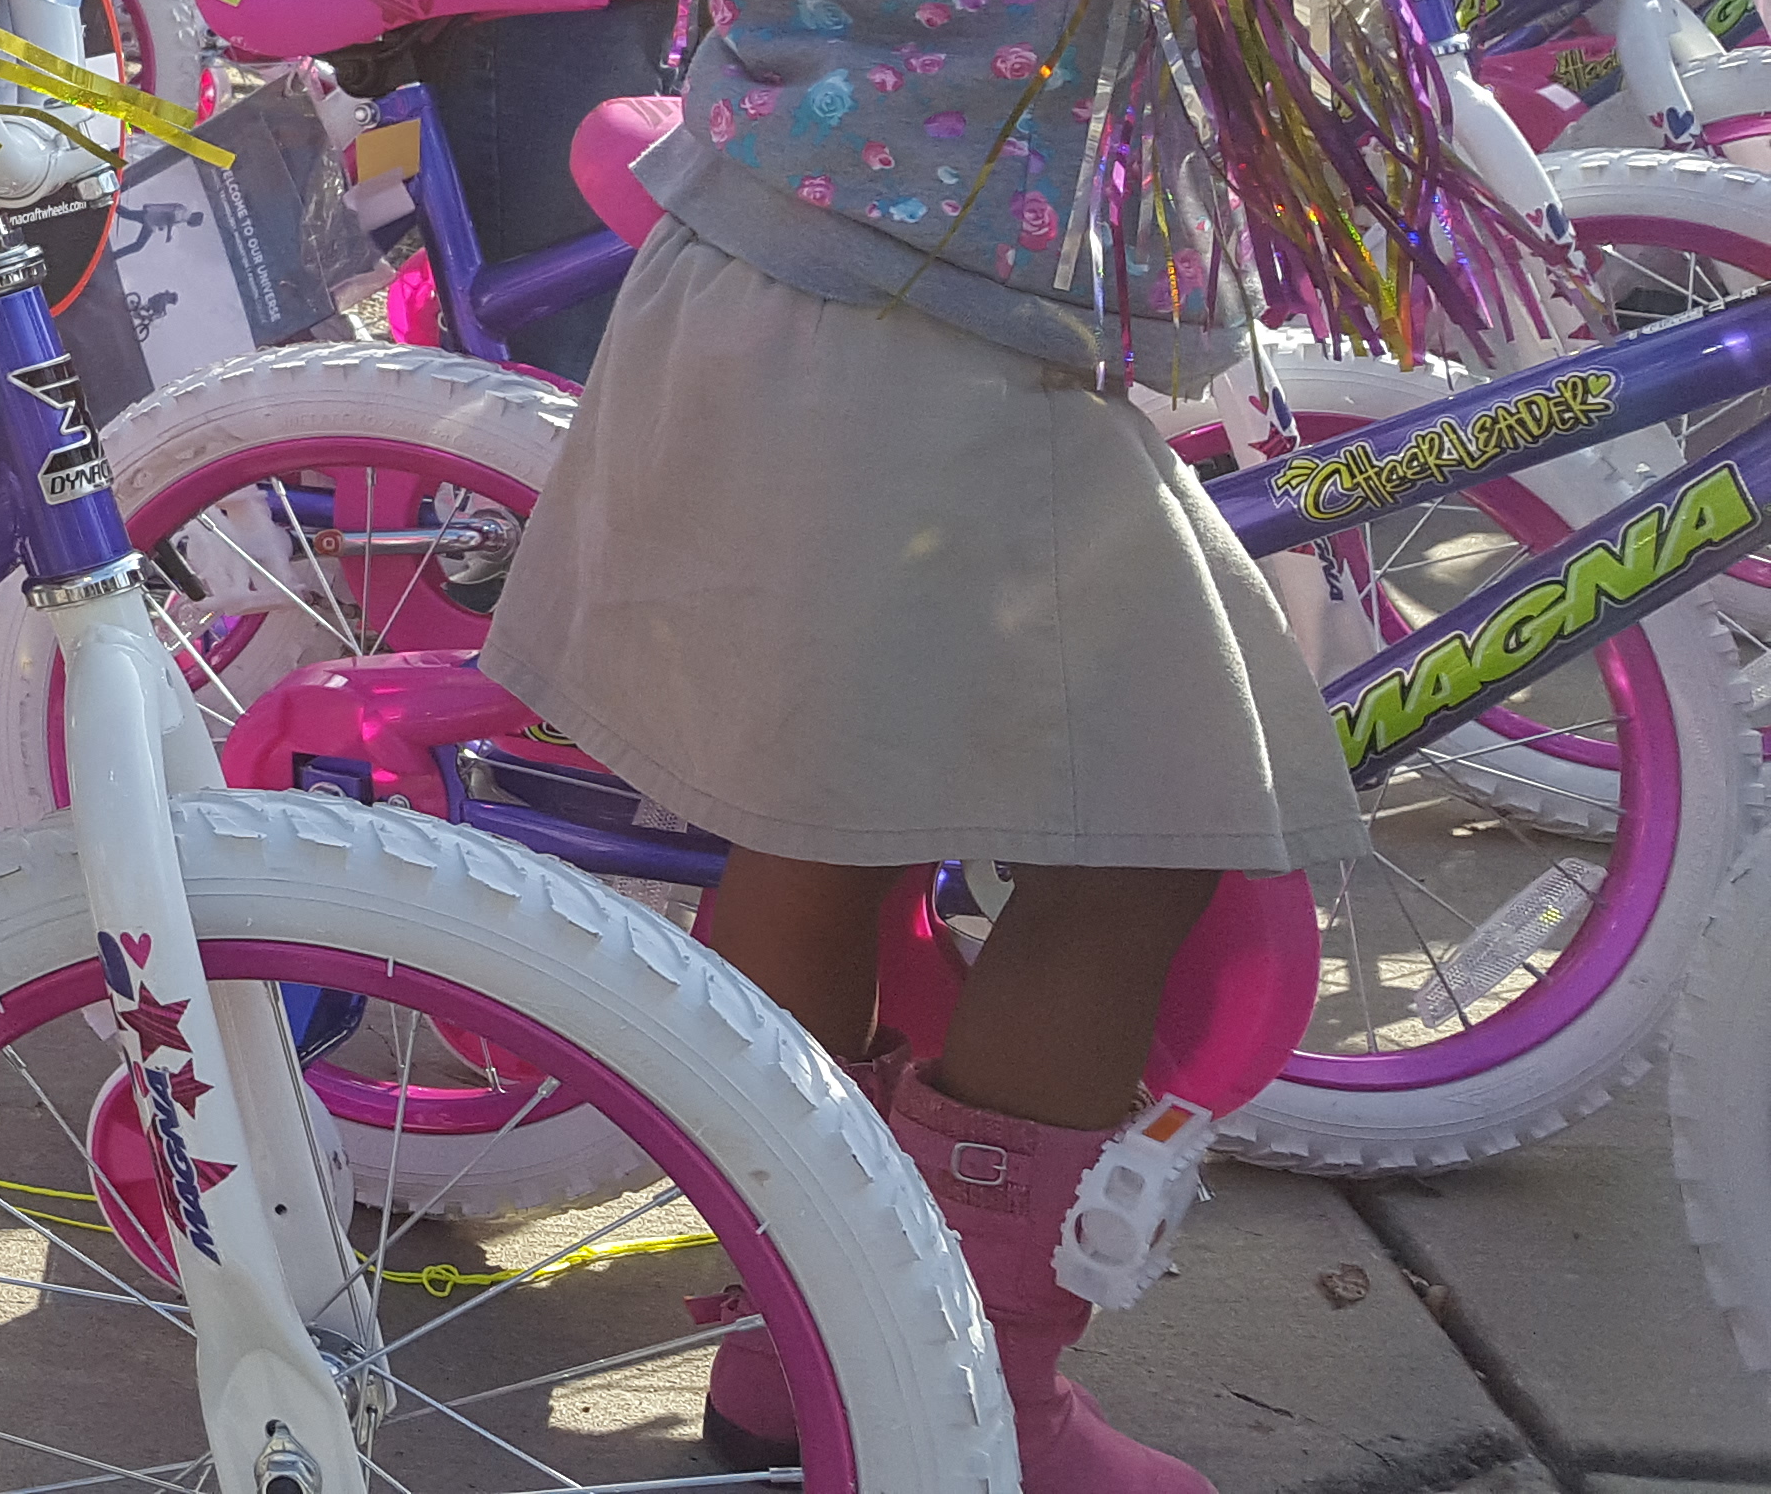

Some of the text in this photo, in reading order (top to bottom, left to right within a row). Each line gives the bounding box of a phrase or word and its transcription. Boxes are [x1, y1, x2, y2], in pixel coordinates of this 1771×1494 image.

[241, 219, 254, 236] TO
[248, 238, 263, 264] OUR
[257, 265, 281, 322] UNIVERSE
[50, 461, 110, 496] DYNAC
